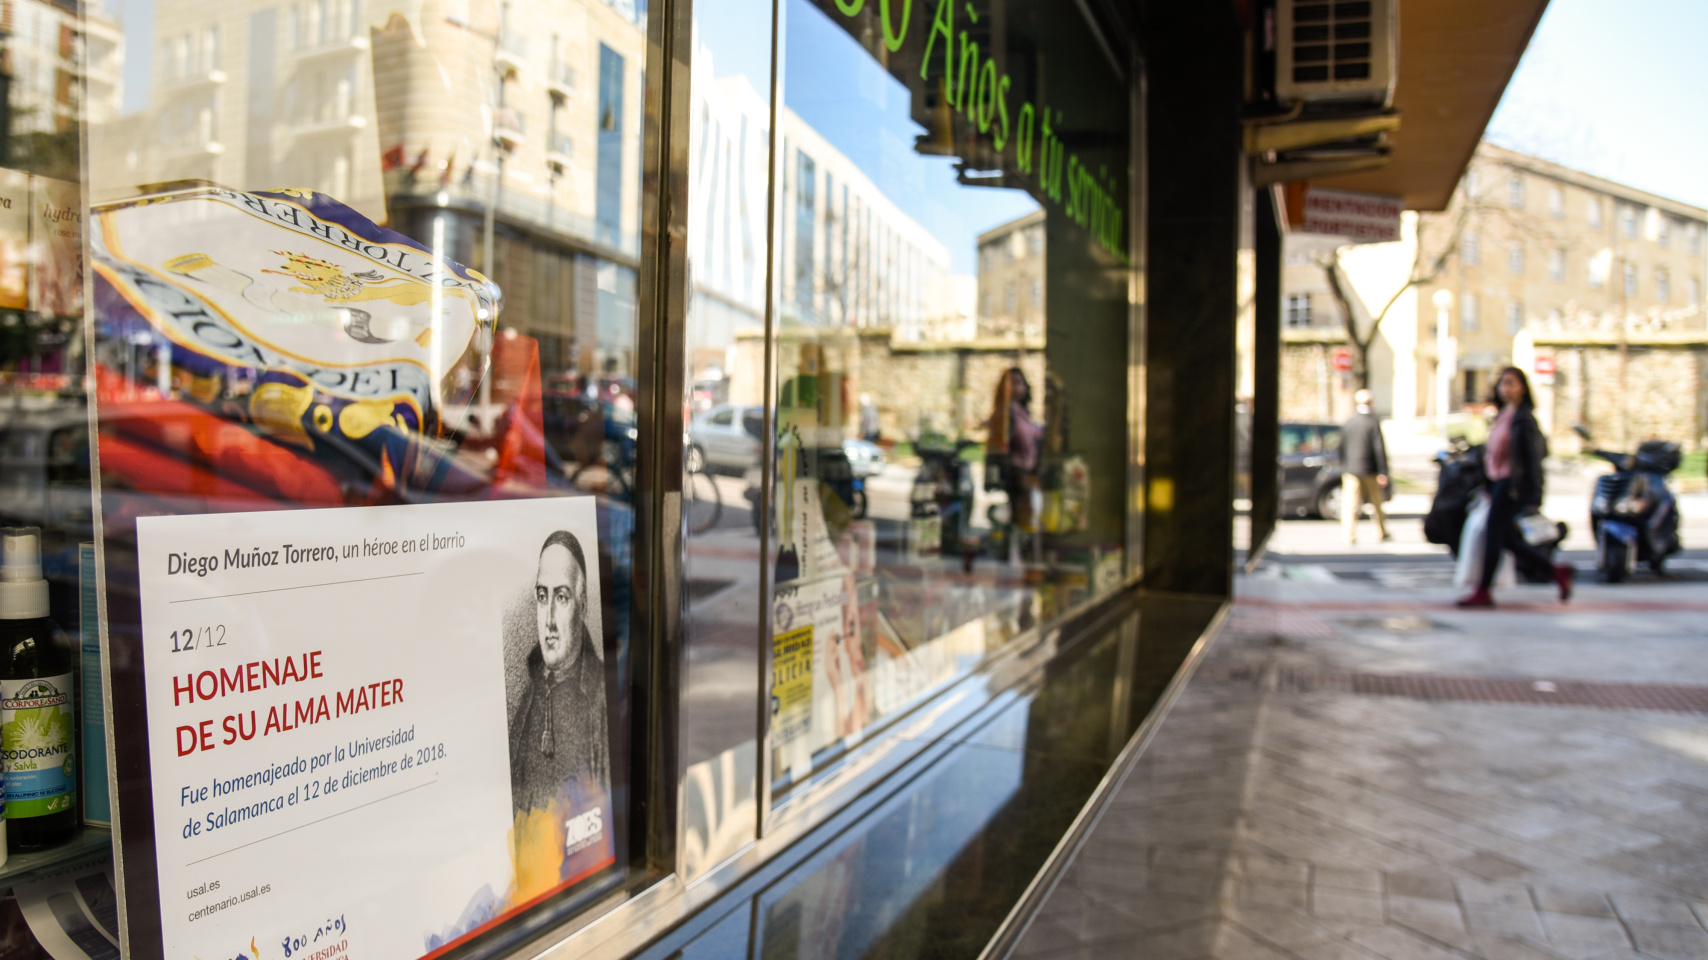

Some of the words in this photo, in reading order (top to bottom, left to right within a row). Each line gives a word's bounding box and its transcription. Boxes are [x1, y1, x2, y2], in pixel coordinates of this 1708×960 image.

[1016, 102, 1035, 174] a
[167, 553, 219, 577] Diego
[224, 546, 279, 571] Muñoz
[283, 544, 339, 565] Torrero,
[343, 543, 359, 558] un
[363, 537, 398, 556] héroe
[402, 539, 416, 553] en
[419, 534, 429, 552] el
[433, 531, 465, 550] barrio
[170, 624, 227, 653] 12/12
[173, 650, 323, 706] HOMENAJE
[5, 699, 44, 709] CORPORE
[47, 695, 66, 706] SANO
[176, 719, 215, 757] DE
[223, 710, 257, 746] SU
[264, 695, 330, 736] ALMA
[336, 678, 404, 718] MATER
[3, 743, 68, 760] SODORANTE
[13, 762, 37, 772] Salvia
[181, 784, 208, 807] Fue
[213, 756, 307, 798] homenajeado
[310, 750, 332, 774] por
[334, 745, 346, 764] la
[349, 724, 415, 759] Universidad
[183, 818, 202, 839] de
[206, 794, 284, 831] Salamanca
[287, 786, 299, 806] el
[303, 780, 320, 801] 12
[323, 776, 339, 795] de
[342, 759, 397, 789] diciembre
[400, 753, 413, 771] de
[416, 742, 447, 767] 2018.
[186, 880, 221, 900] usal.es
[188, 883, 271, 922] centenario.usal.es
[281, 935, 307, 958] 800
[313, 913, 347, 942] AÑOS
